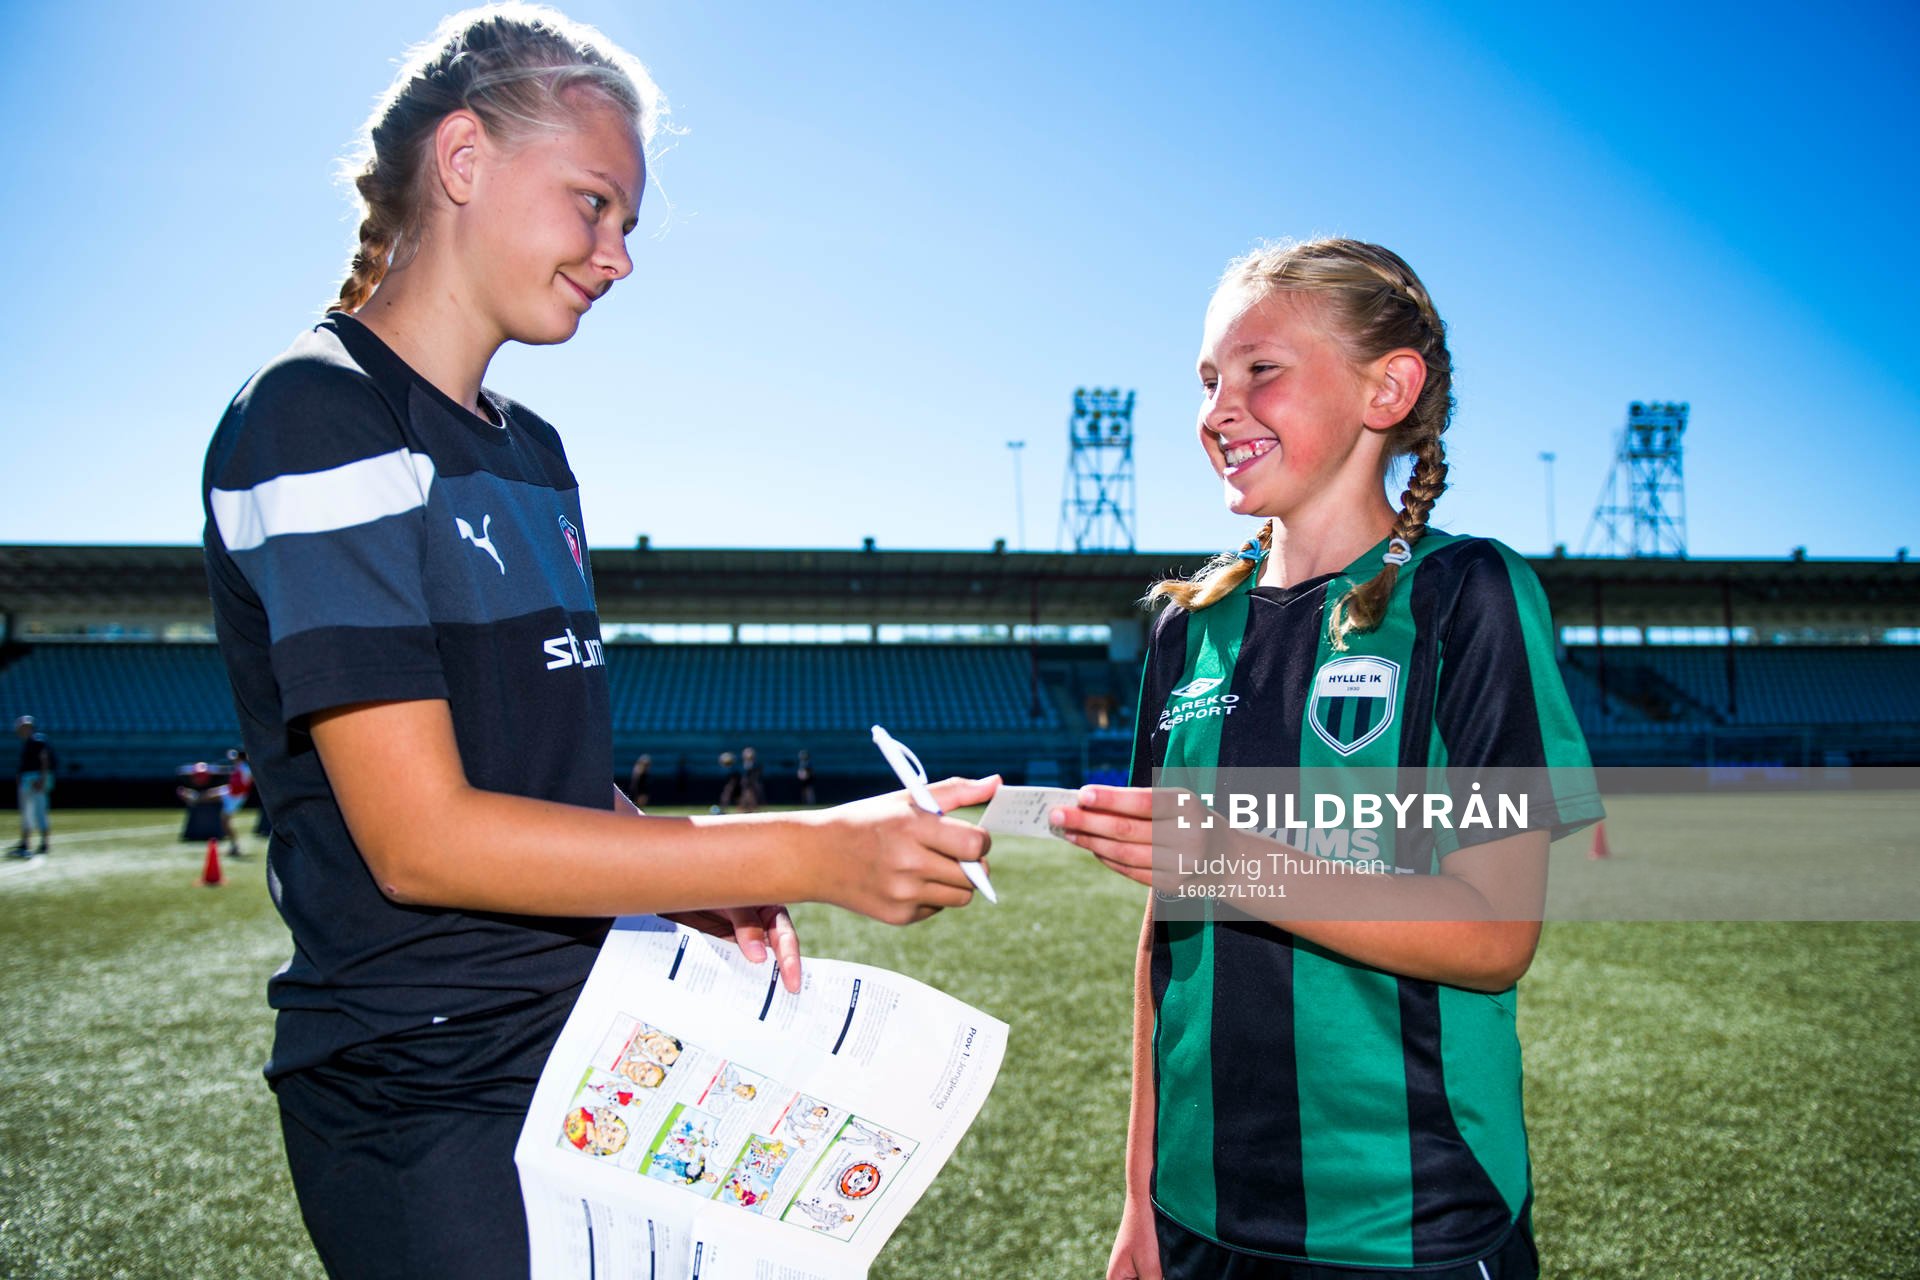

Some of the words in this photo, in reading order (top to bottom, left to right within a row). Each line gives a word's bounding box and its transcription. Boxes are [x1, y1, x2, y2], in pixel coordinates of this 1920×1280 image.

[1329, 674, 1367, 683] HYLLIE
[1369, 674, 1382, 683] IK
[1160, 694, 1240, 719] BAREKO
[965, 1027, 977, 1050] Prov
